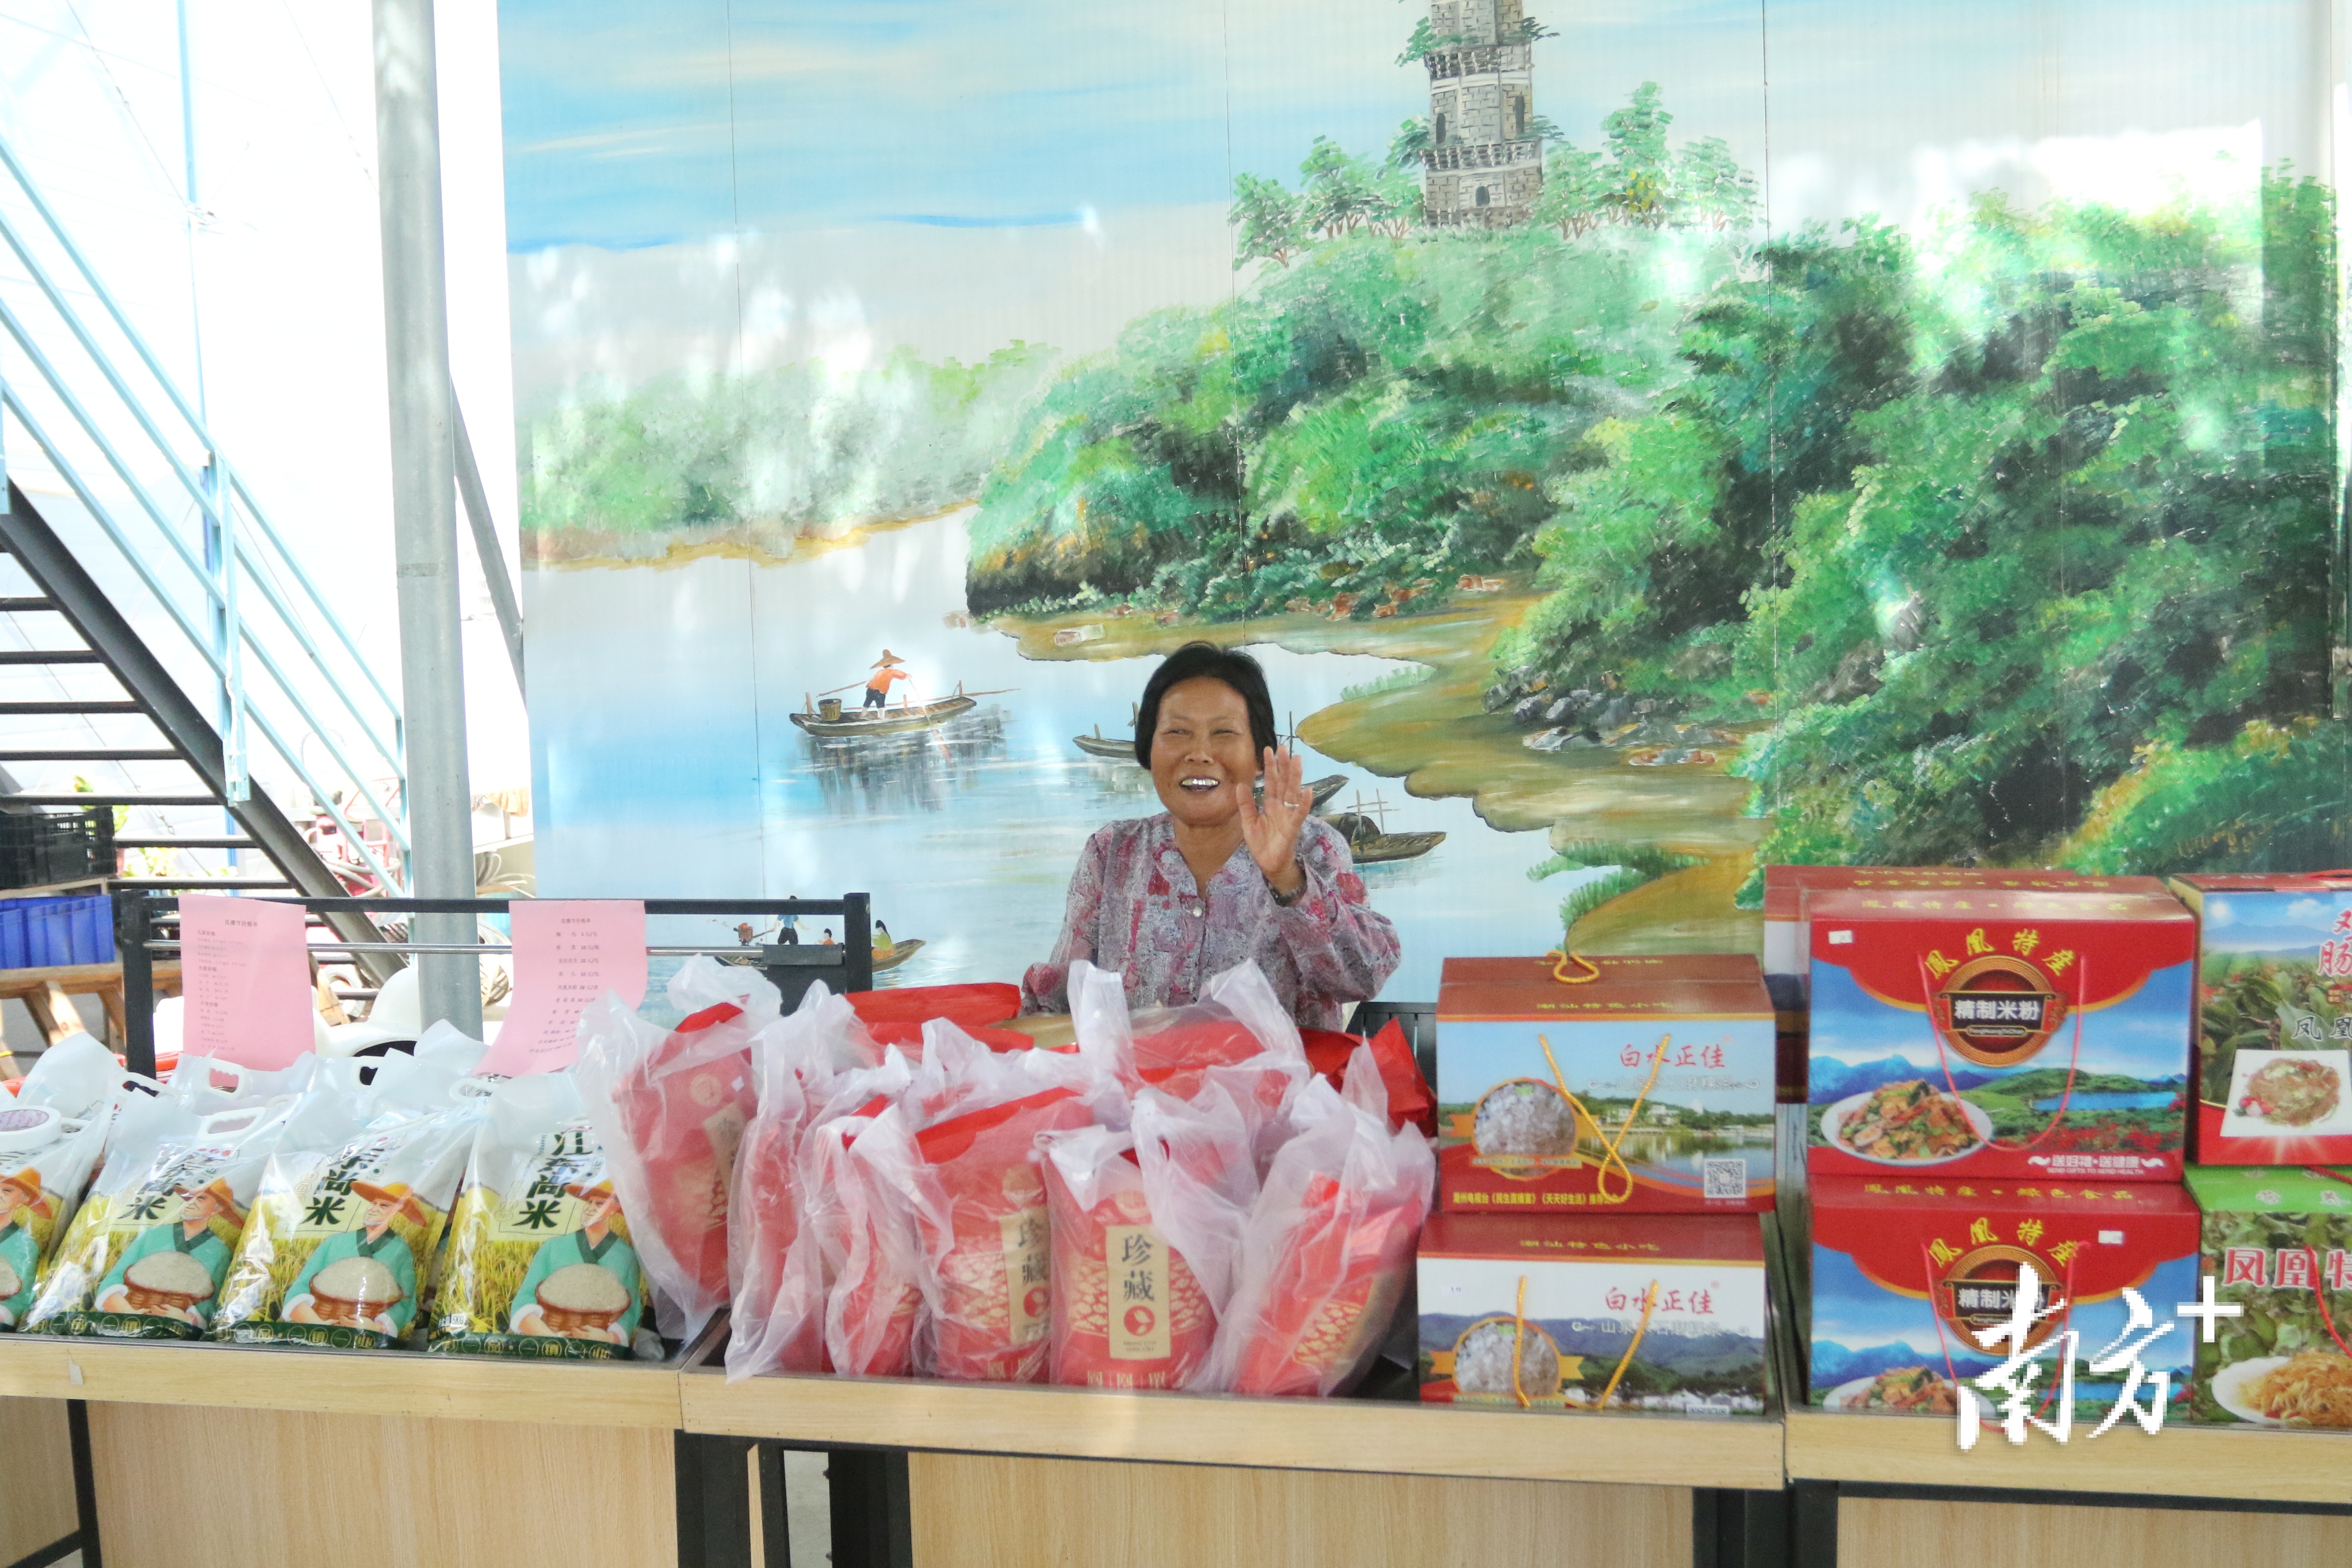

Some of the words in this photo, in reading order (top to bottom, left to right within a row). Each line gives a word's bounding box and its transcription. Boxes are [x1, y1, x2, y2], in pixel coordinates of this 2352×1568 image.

[1954, 999, 2040, 1021] 精制米粉
[1620, 1043, 1726, 1069] 白水正佳
[1121, 1234, 1155, 1303] 珍藏
[1605, 1286, 1714, 1314] 白水正佳
[452, 1314, 464, 1325] 5KG
